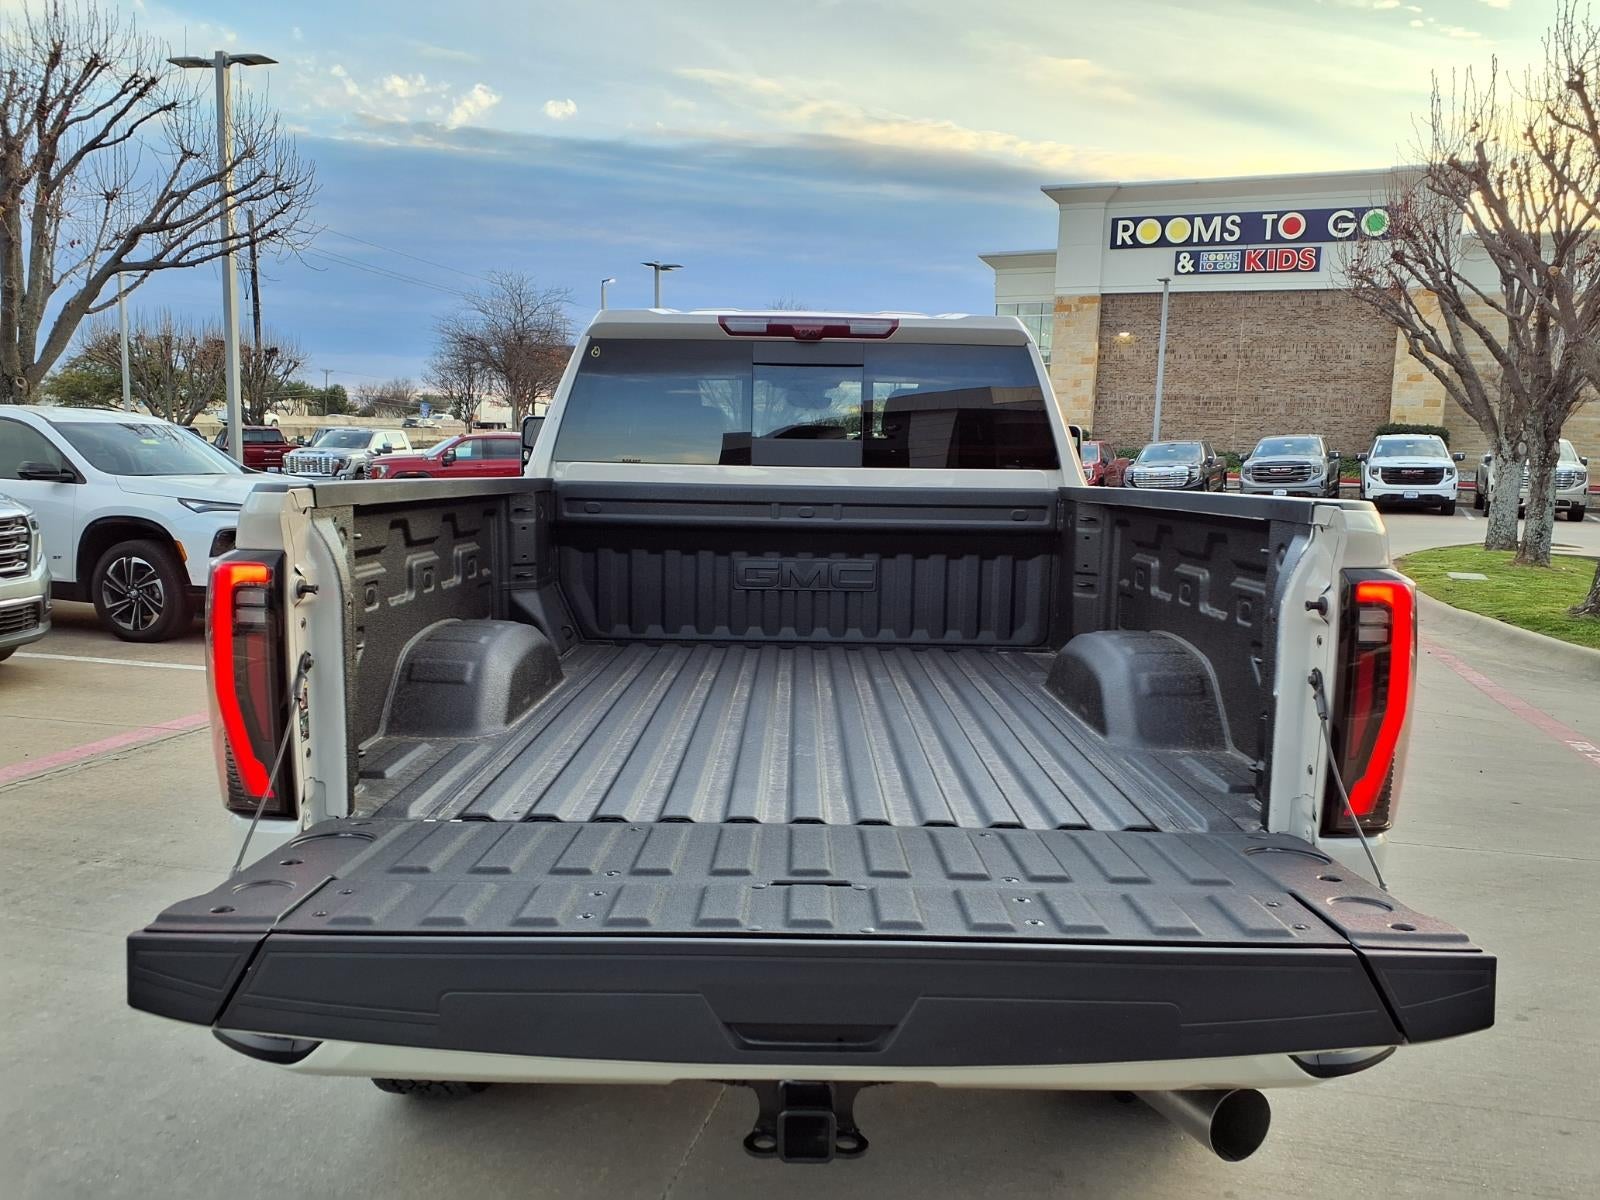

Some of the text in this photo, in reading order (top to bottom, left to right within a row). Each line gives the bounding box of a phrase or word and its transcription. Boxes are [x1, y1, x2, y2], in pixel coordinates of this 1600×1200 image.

[1116, 208, 1391, 246] ROOMS TO GO
[1177, 248, 1316, 274] & KIDS
[1202, 253, 1238, 261] ROOMS
[1203, 261, 1232, 271] TO GO
[736, 561, 874, 588] GMC
